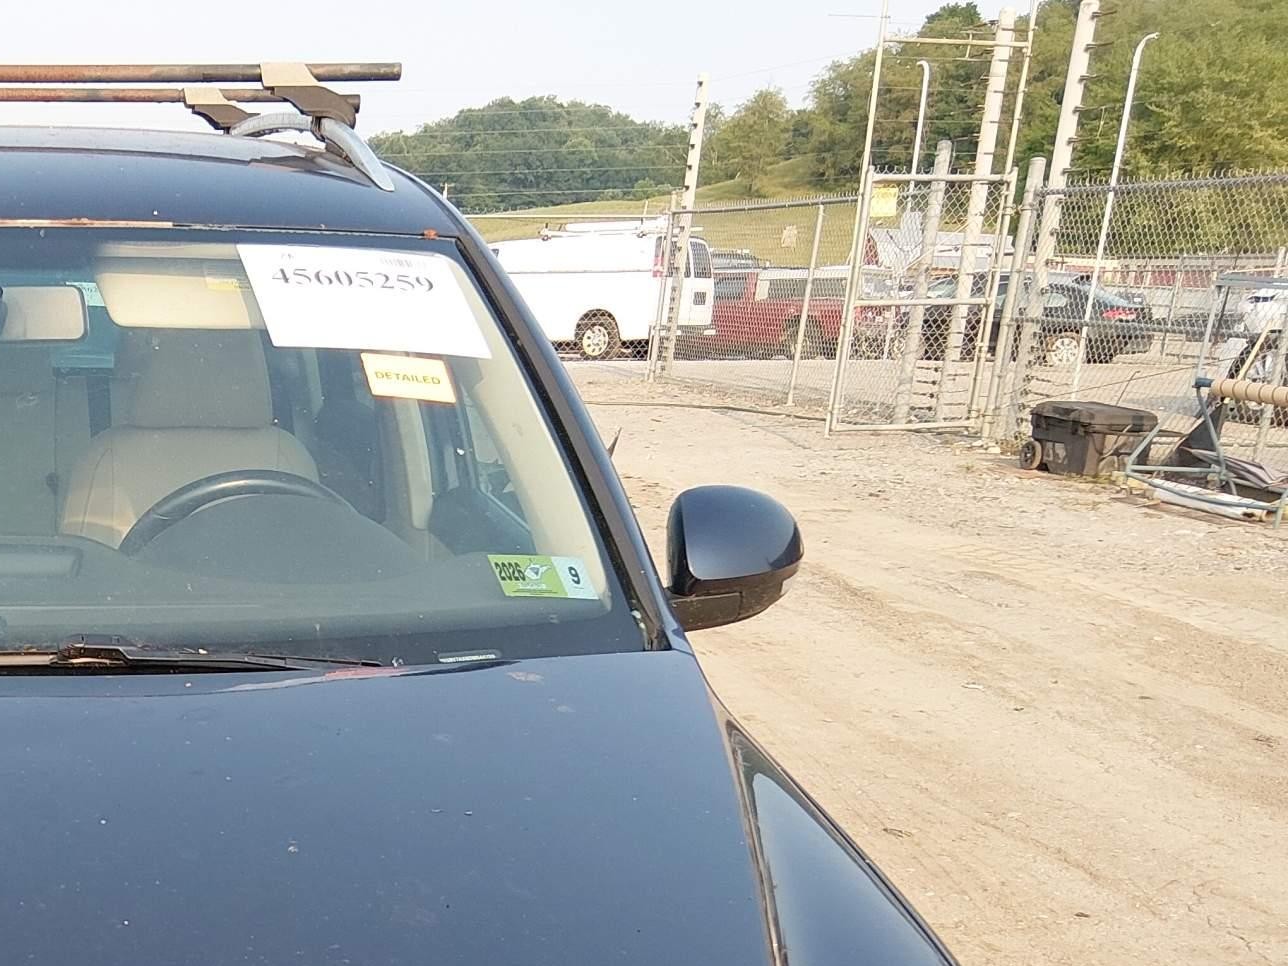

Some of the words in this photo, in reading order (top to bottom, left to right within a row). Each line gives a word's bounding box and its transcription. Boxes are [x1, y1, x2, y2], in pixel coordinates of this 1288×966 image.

[272, 267, 434, 292] 45605259
[374, 370, 441, 386] DETAILED
[494, 562, 526, 582] 2026
[568, 566, 580, 585] 9
